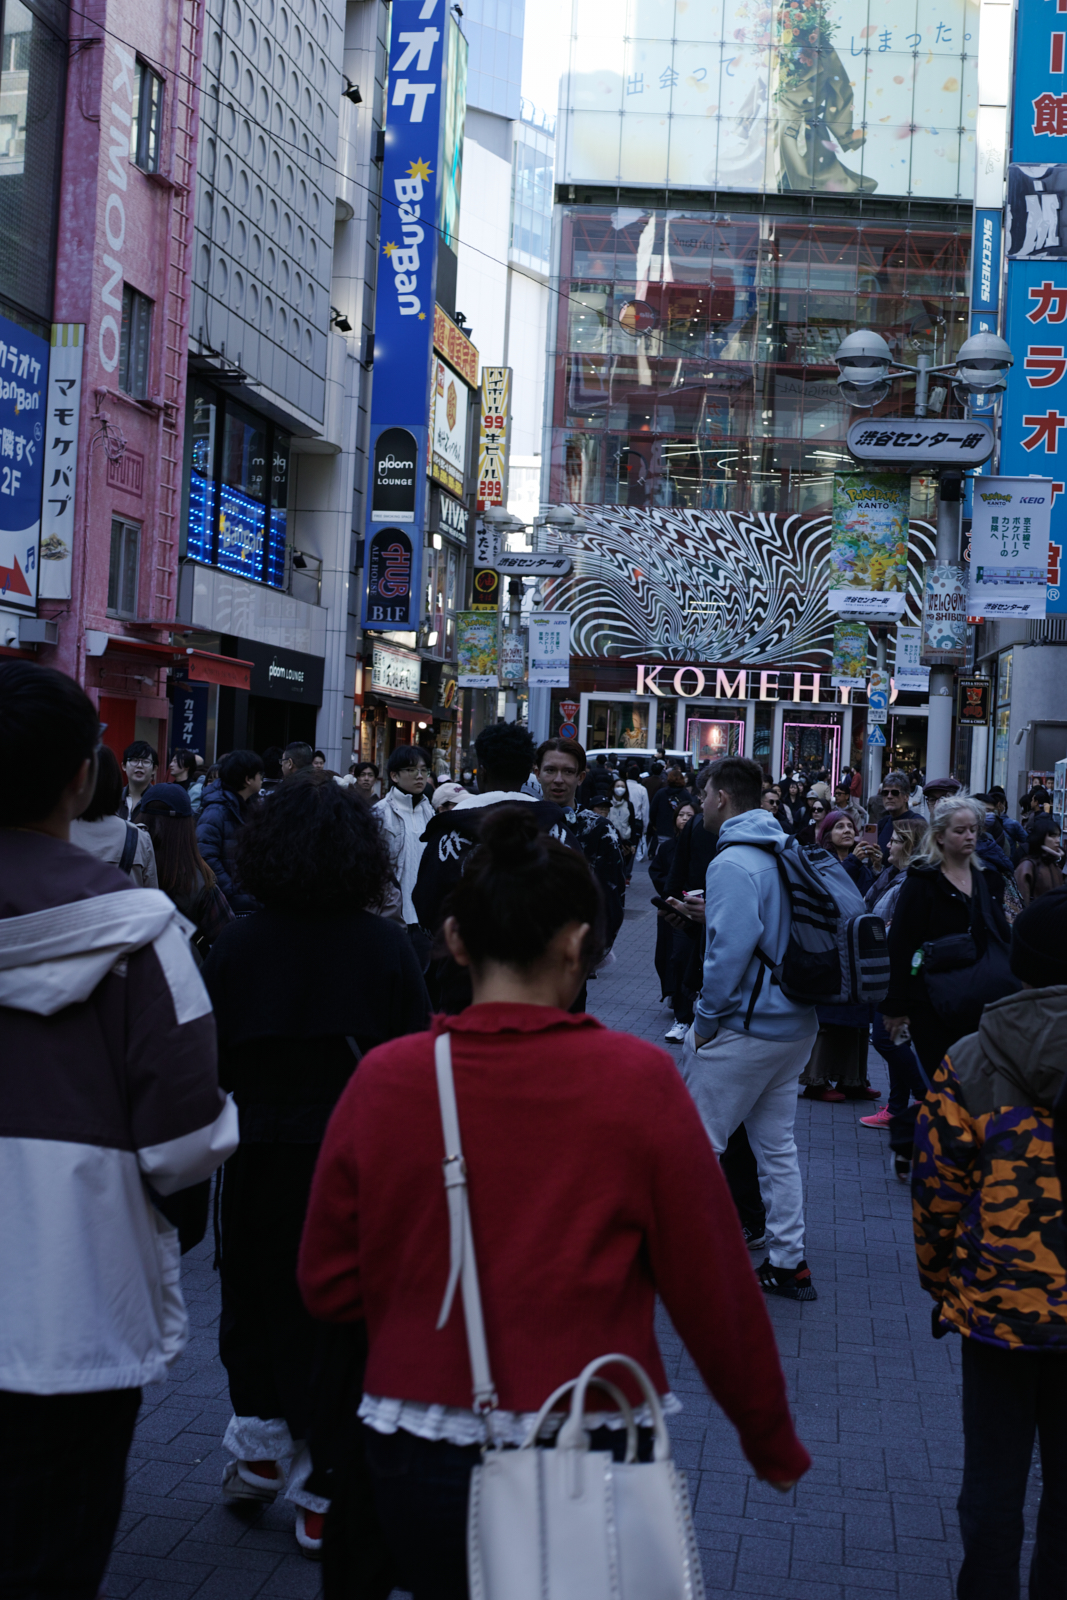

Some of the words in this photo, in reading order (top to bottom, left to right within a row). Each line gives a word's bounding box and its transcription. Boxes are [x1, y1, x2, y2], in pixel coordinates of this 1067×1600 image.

[627, 57, 736, 96] 出会って
[851, 21, 972, 57] しまった。
[1031, 0, 1067, 137] ー館
[98, 43, 134, 373] KIMONO
[391, 177, 423, 316] BanBan
[982, 218, 993, 302] SKECHERS
[487, 370, 503, 413] ハイボール
[484, 415, 504, 428] 99
[0, 427, 36, 466] 隣すぐ
[47, 378, 77, 517] マモケバブ
[484, 433, 500, 478] 生ビール
[855, 430, 985, 449] 渋谷センター街
[378, 454, 412, 476] ploom
[1, 466, 21, 497] 2F
[479, 480, 501, 496] 299
[440, 494, 465, 533] VIVA
[1019, 496, 1045, 504] KEIO
[990, 516, 999, 540] 冒険へ
[1000, 517, 1010, 557] カントーの
[1022, 517, 1031, 550] 京王線で
[378, 543, 410, 598] HUB
[497, 557, 567, 568] 渋谷センター街
[370, 564, 378, 595] HOUSE
[372, 606, 405, 621] B1F
[843, 596, 890, 604] 渋谷センター街
[928, 593, 966, 611] WELCOME
[984, 603, 1031, 611] 渋谷センター街
[269, 657, 286, 687] ploom
[286, 669, 304, 683] LOUNGE
[182, 698, 194, 744] カラオケ
